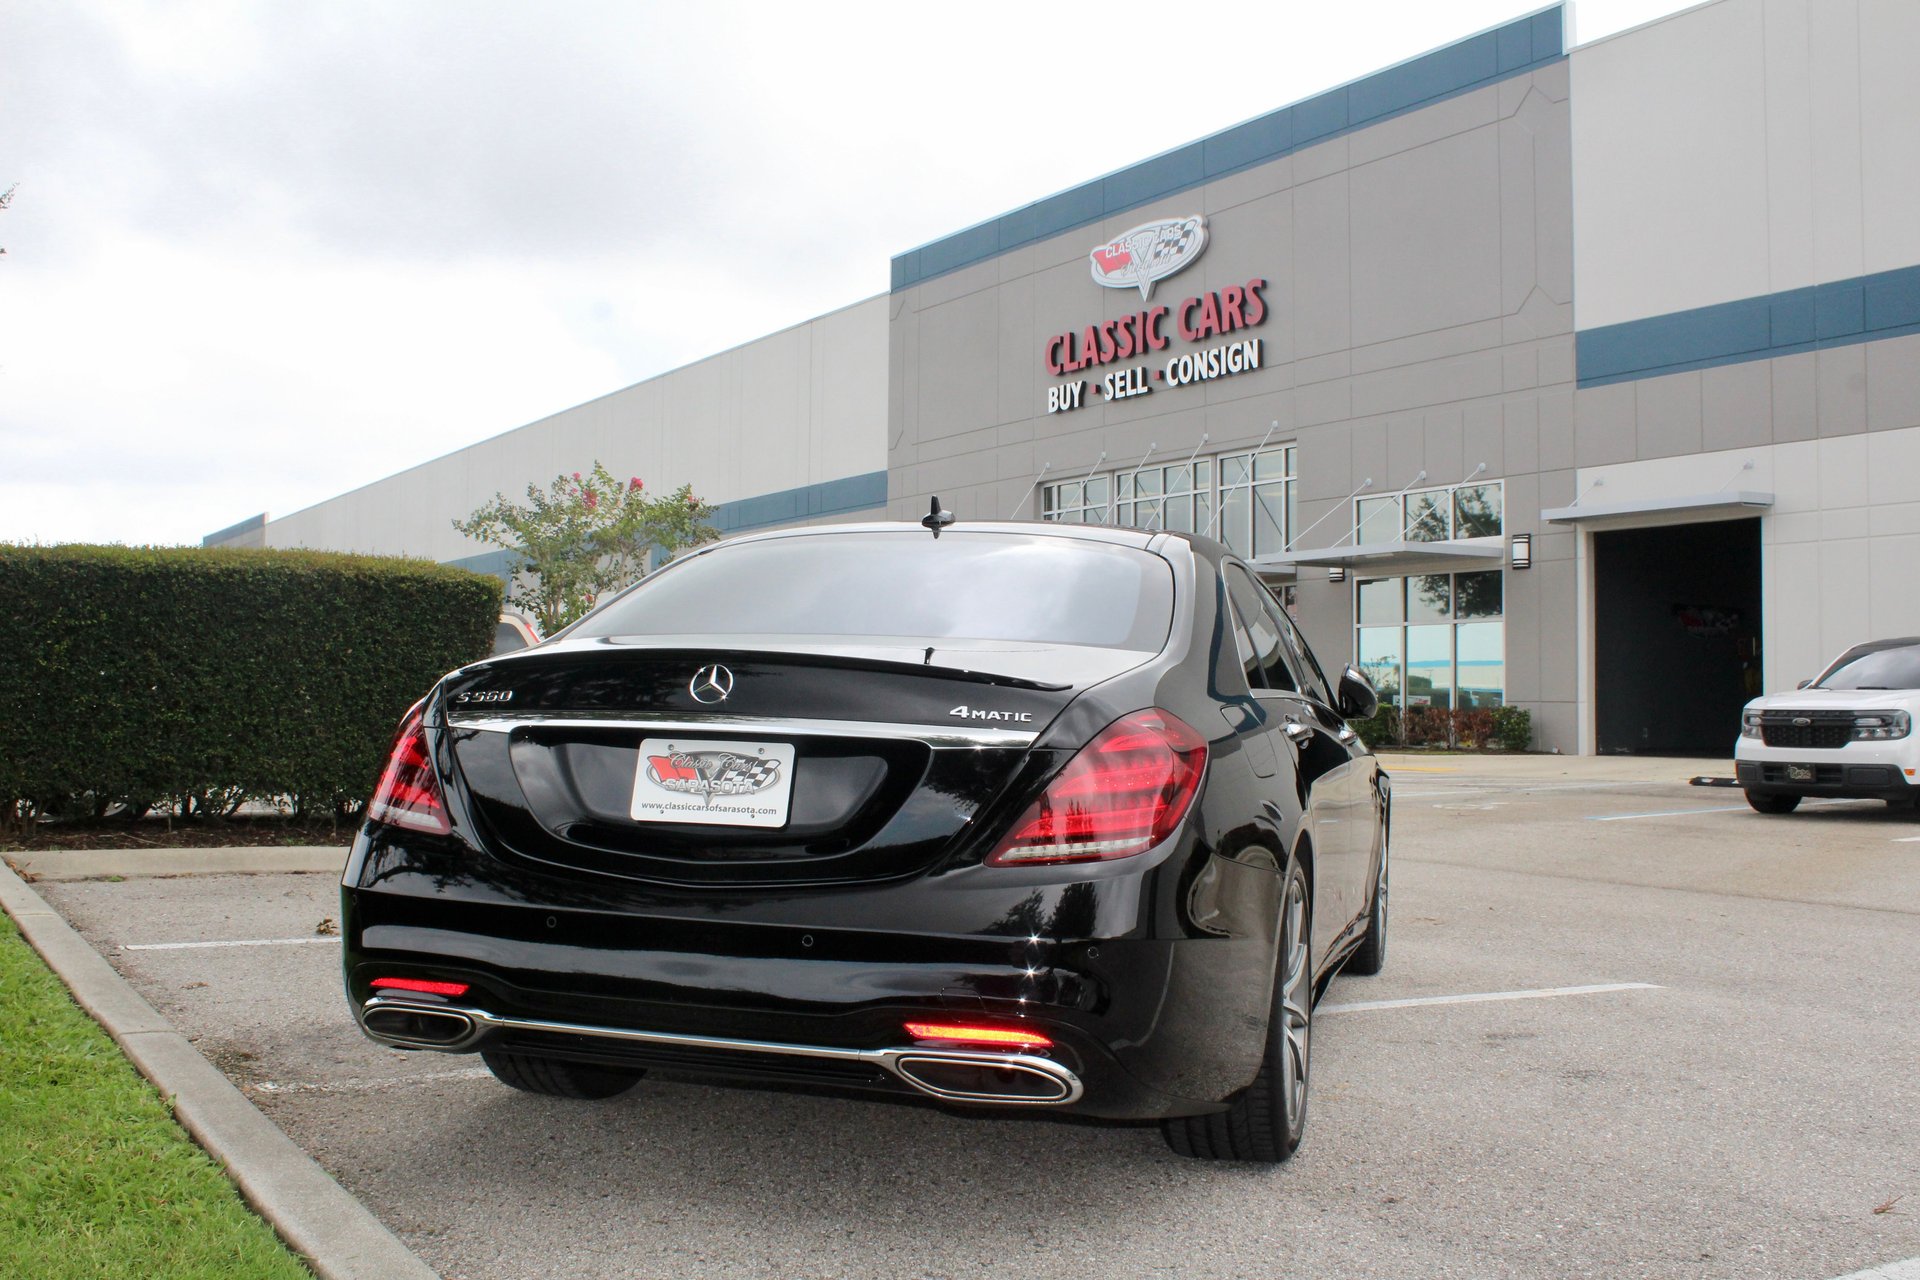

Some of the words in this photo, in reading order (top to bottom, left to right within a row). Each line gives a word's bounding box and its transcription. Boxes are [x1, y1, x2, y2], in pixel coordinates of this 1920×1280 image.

[1045, 305, 1167, 376] CLASSIC
[1177, 279, 1266, 342] CARS
[1048, 380, 1085, 413] BUY
[1104, 367, 1149, 401] SELL
[1166, 339, 1260, 387] CONSIGN
[949, 705, 1033, 722] 4MATIC
[669, 751, 713, 769] Classic
[718, 753, 755, 772] Cars
[664, 778, 755, 795] SARASOTA
[641, 801, 777, 815] www.classiccarsofsarasota.com
